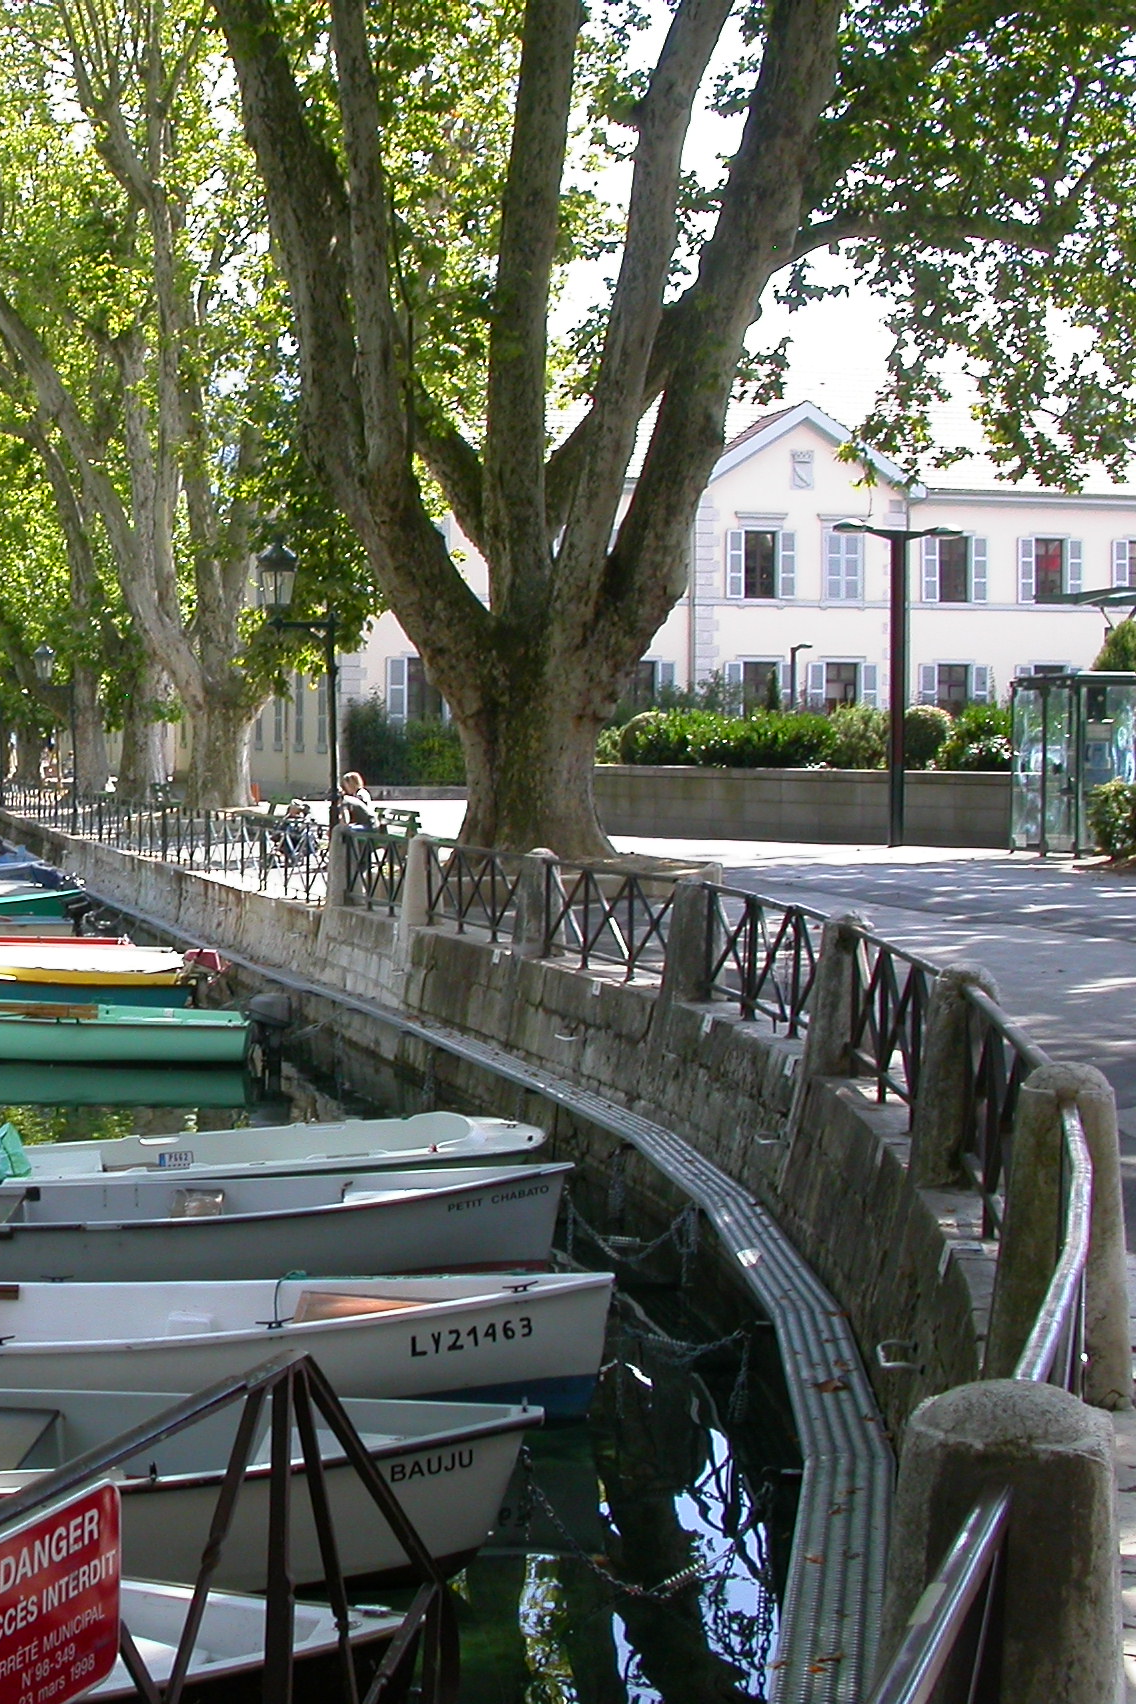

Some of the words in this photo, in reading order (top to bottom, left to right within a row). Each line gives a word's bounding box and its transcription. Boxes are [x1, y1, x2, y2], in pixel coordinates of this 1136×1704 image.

[447, 1197, 483, 1213] PETIT
[490, 1184, 550, 1205] CHABATO
[410, 1316, 534, 1358] LY21463
[390, 1448, 474, 1483] BAUJU
[0, 1508, 99, 1594] DANGER
[42, 1550, 117, 1614] INTERDIT
[42, 1605, 106, 1654] MUNICIPAL
[37, 1676, 66, 1702] mars
[70, 1653, 95, 1682] 1998
